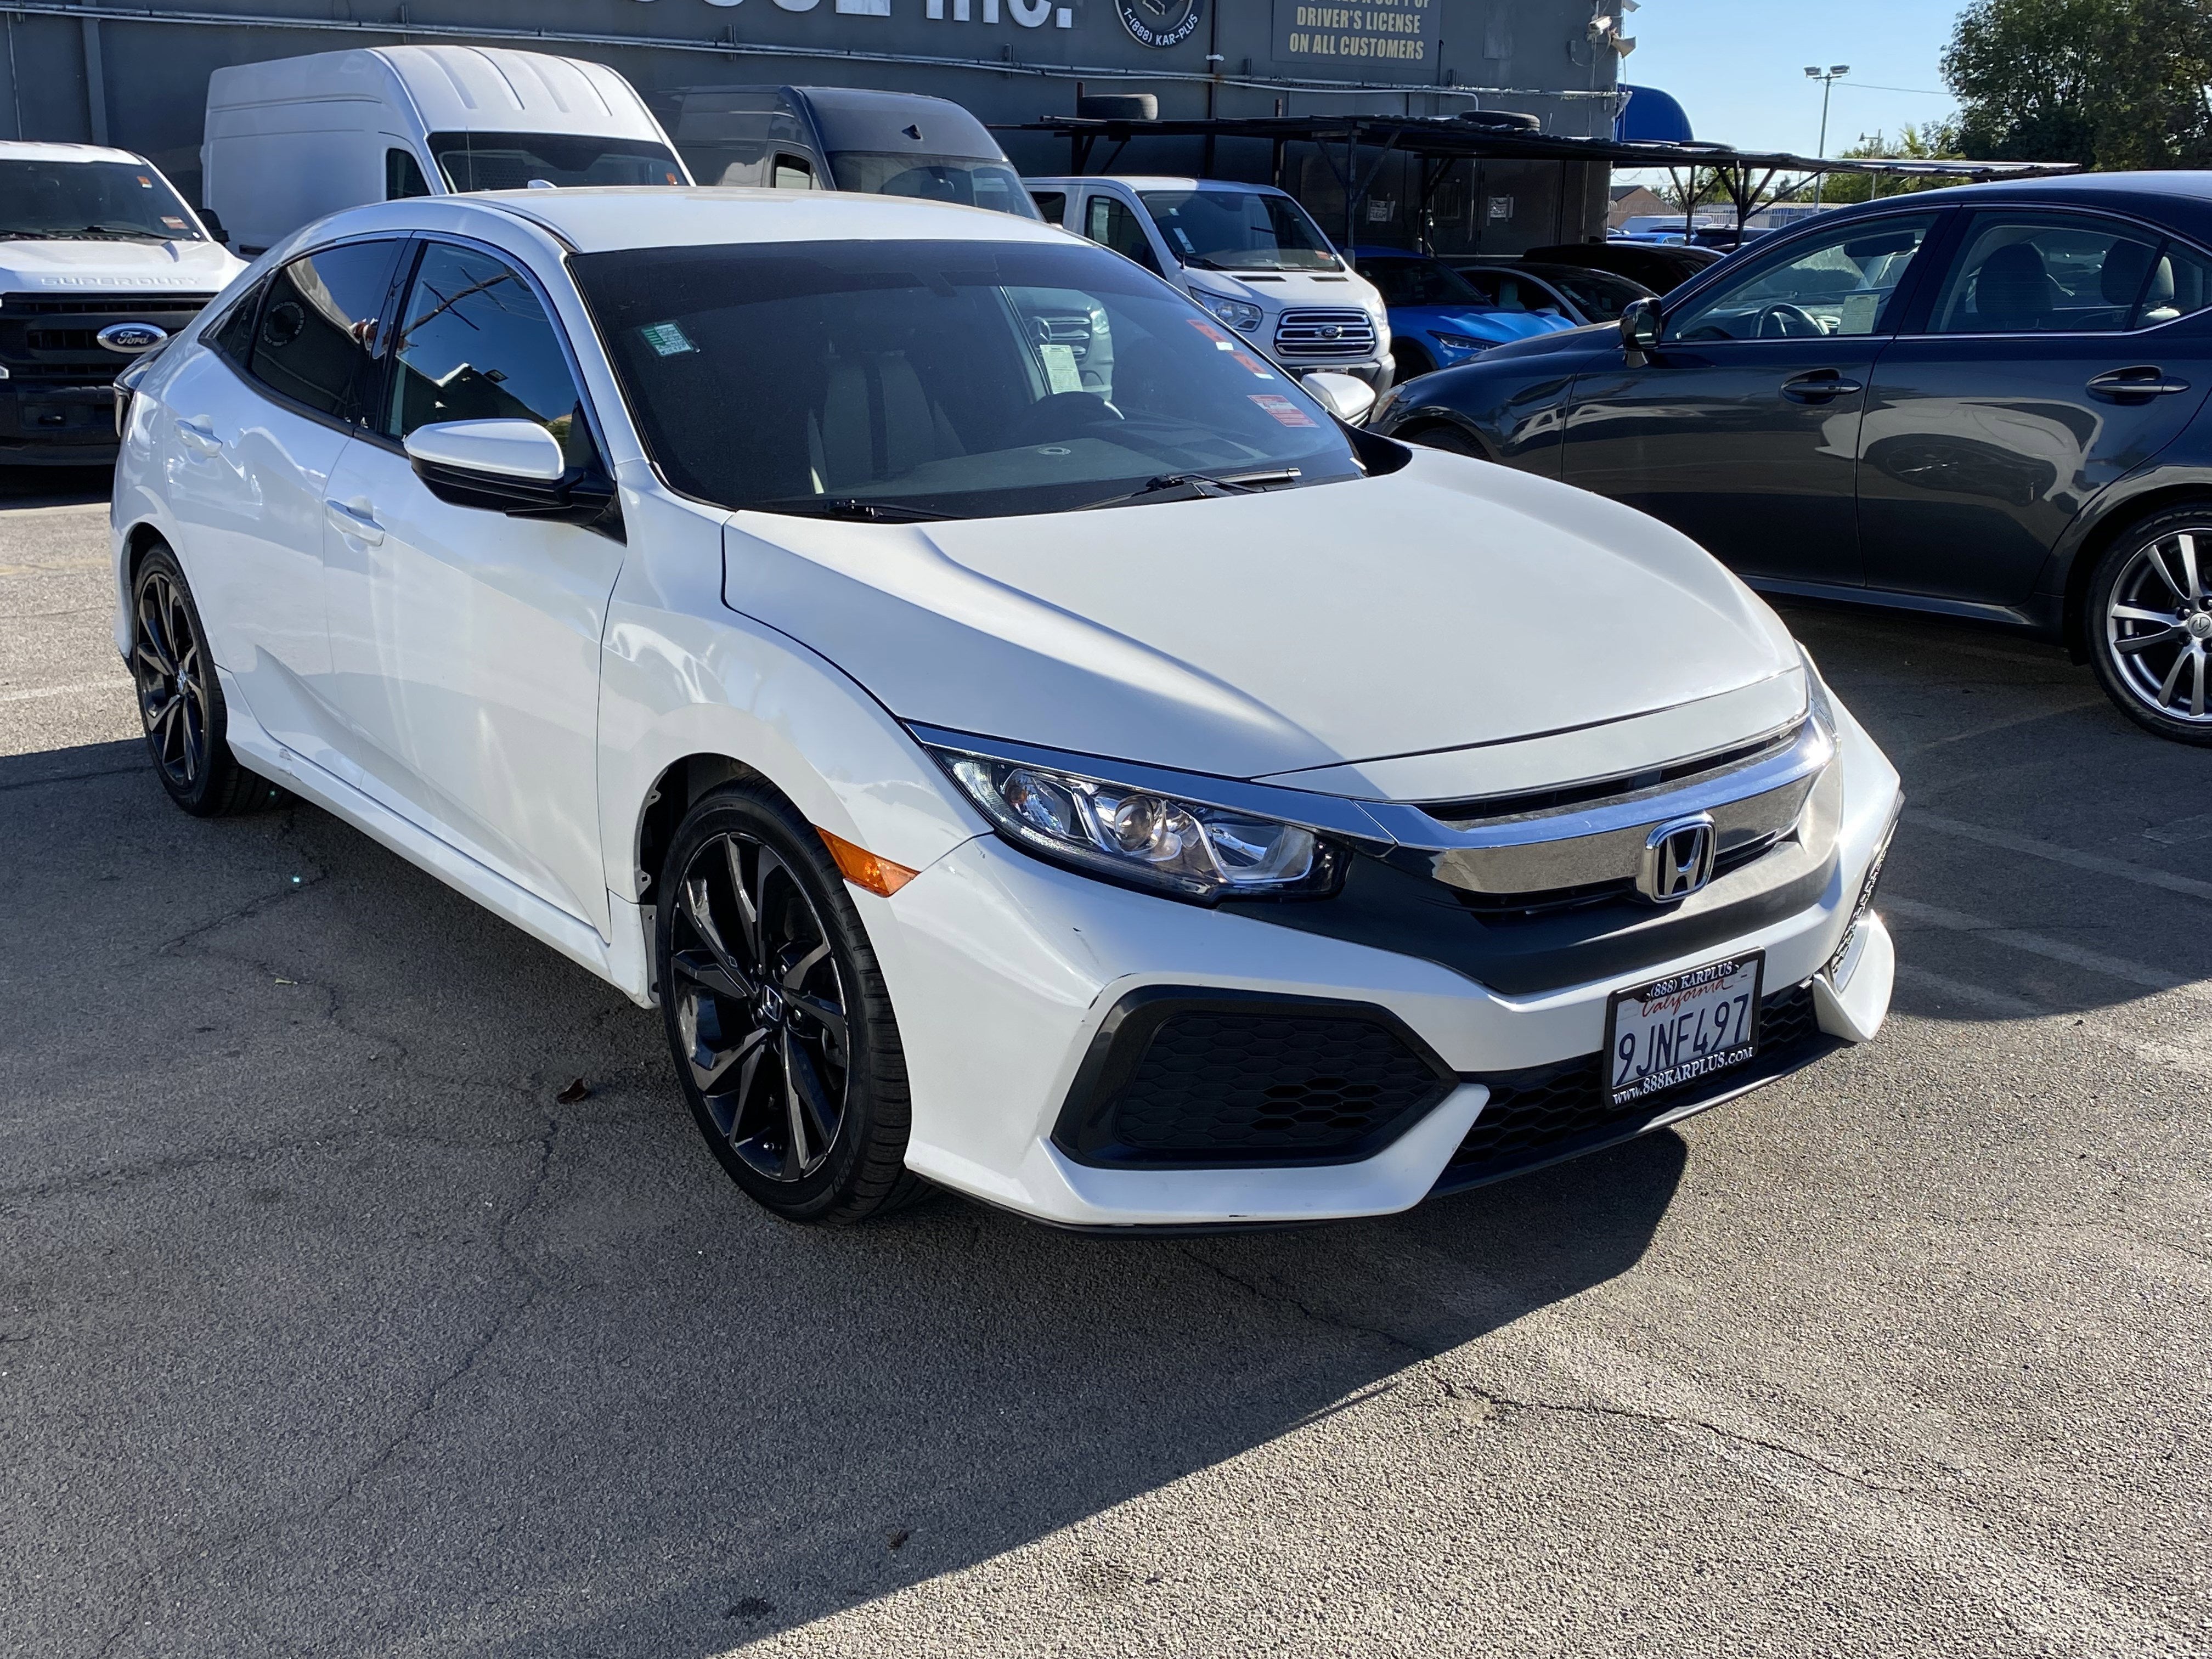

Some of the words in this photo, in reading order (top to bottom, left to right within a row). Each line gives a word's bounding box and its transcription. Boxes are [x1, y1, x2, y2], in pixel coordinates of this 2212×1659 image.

[1124, 7, 1153, 43] 1-(888)
[1155, 13, 1198, 46] KAR-PLUS
[1296, 6, 1363, 30] DRIVER'S
[1365, 11, 1421, 34] LICENSE
[1289, 33, 1310, 53] ON
[1312, 35, 1336, 55] ALL
[1340, 36, 1425, 60] CUSTOMERS
[41, 276, 133, 286] SUPER
[137, 276, 201, 285] DUTY
[116, 330, 149, 345] Ford
[1651, 979, 1678, 998] (888)
[1680, 961, 1733, 990] KARPLUS
[1642, 978, 1734, 1018] California
[1616, 993, 1749, 1087] 9JNF497
